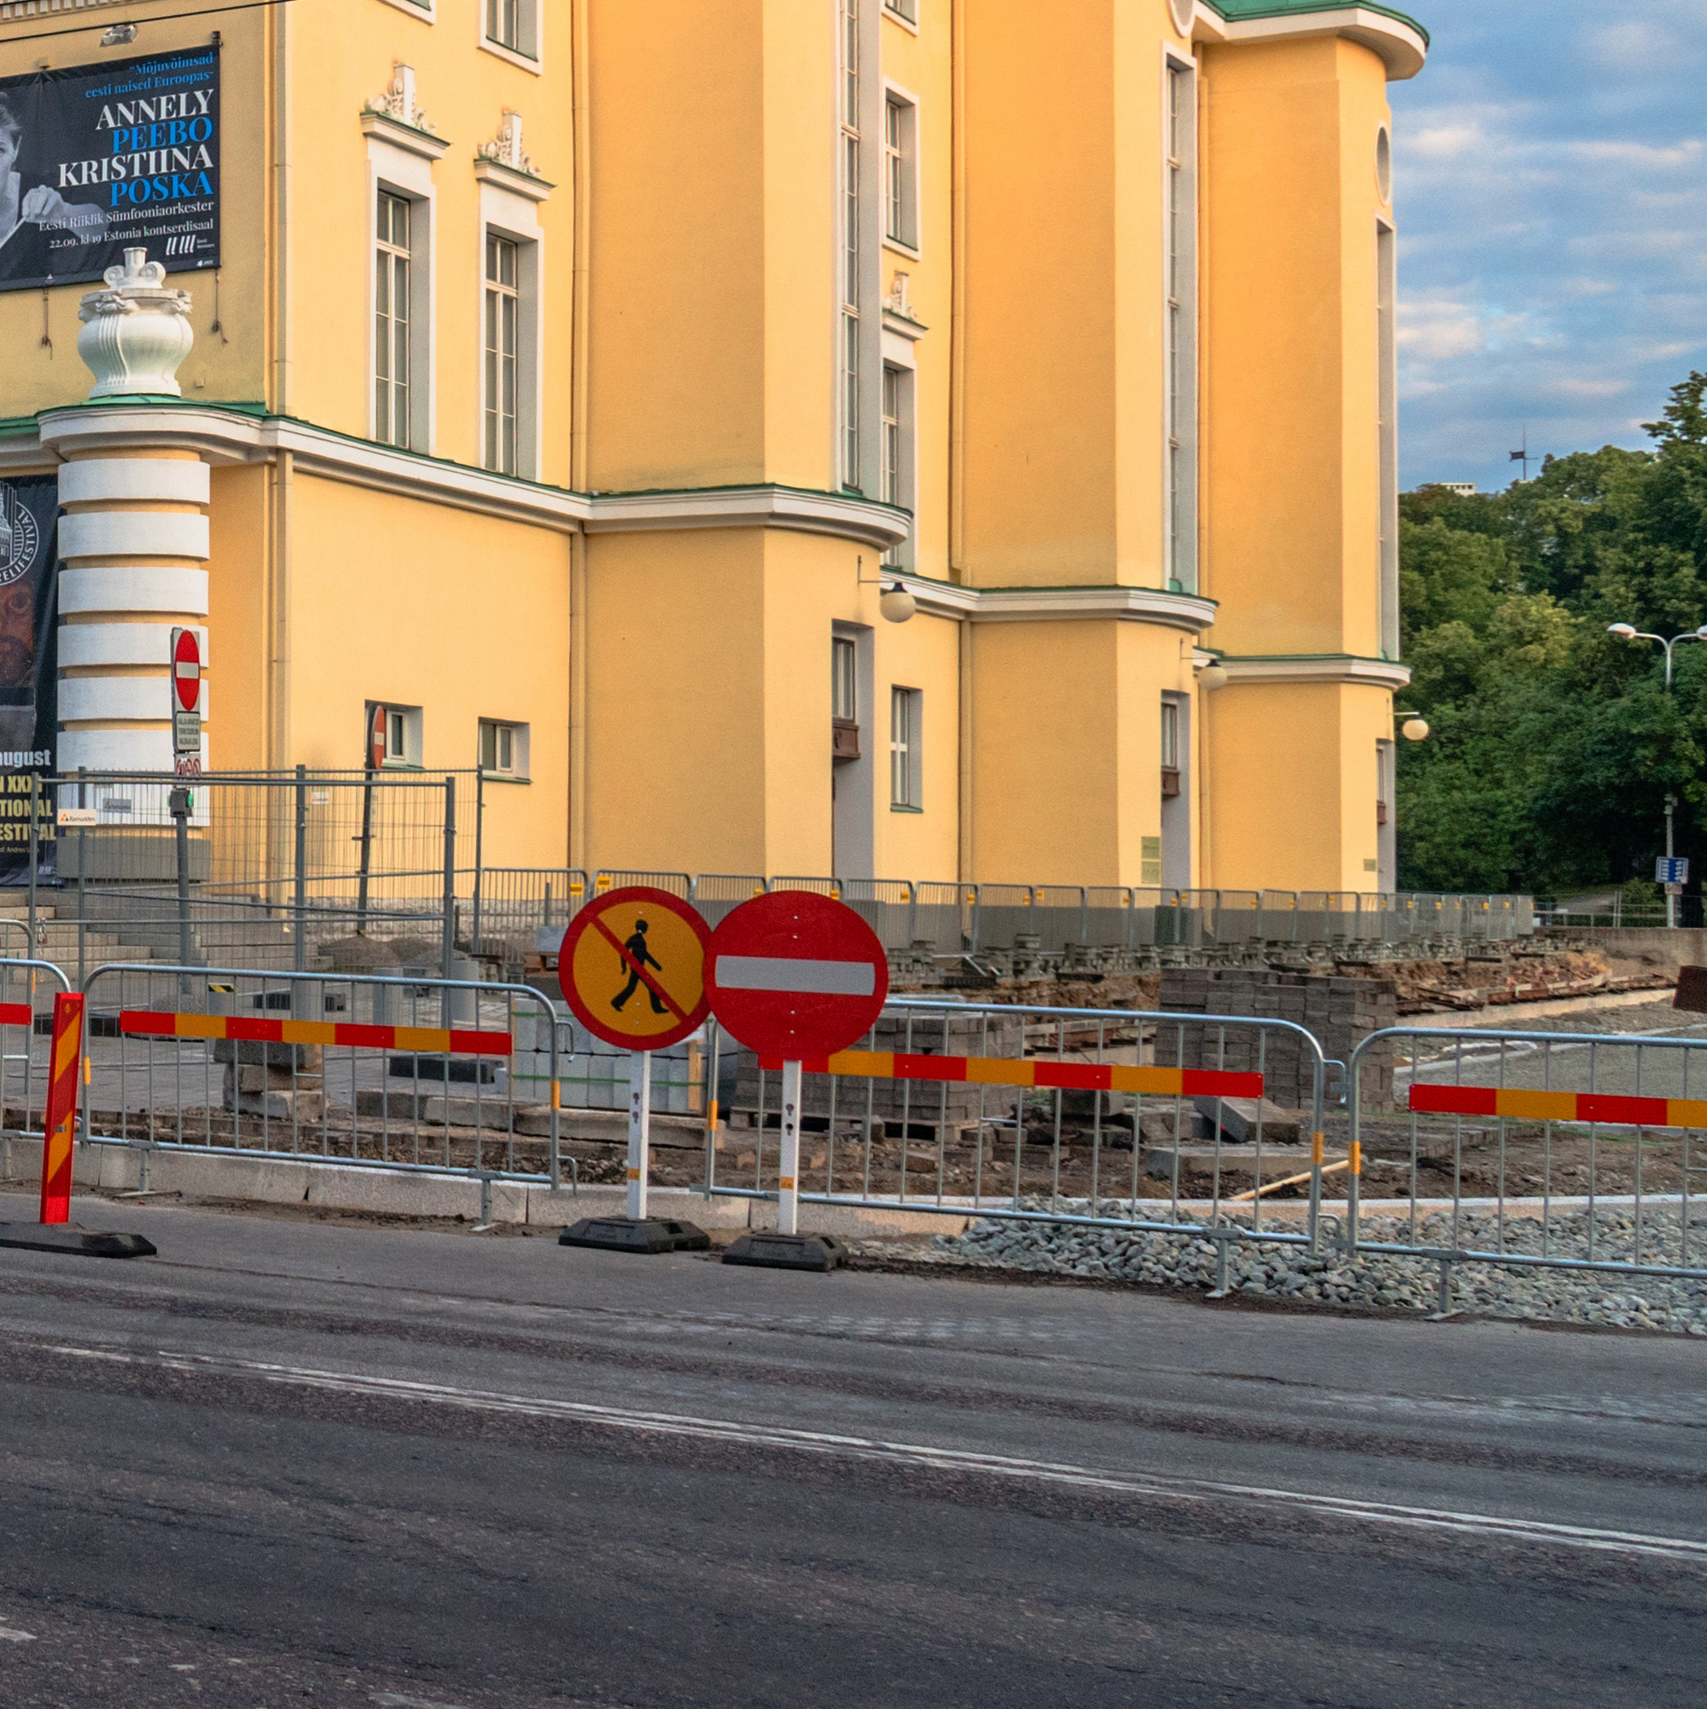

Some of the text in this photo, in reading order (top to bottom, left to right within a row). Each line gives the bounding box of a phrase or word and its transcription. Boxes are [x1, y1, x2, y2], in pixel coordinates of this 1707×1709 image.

[85, 84, 112, 98] eesti
[114, 78, 151, 94] naised
[96, 89, 214, 130] ANNELY
[112, 116, 213, 154] PEEBO
[58, 144, 214, 188] KRISTIINA
[110, 171, 214, 207] POSKA
[39, 201, 214, 232] Eesti Riiklik Sümfooniaorkester
[49, 238, 79, 249] 22.09.
[91, 235, 102, 245] 19
[104, 227, 142, 242] Estonia
[143, 218, 214, 236] kontserdisaal
